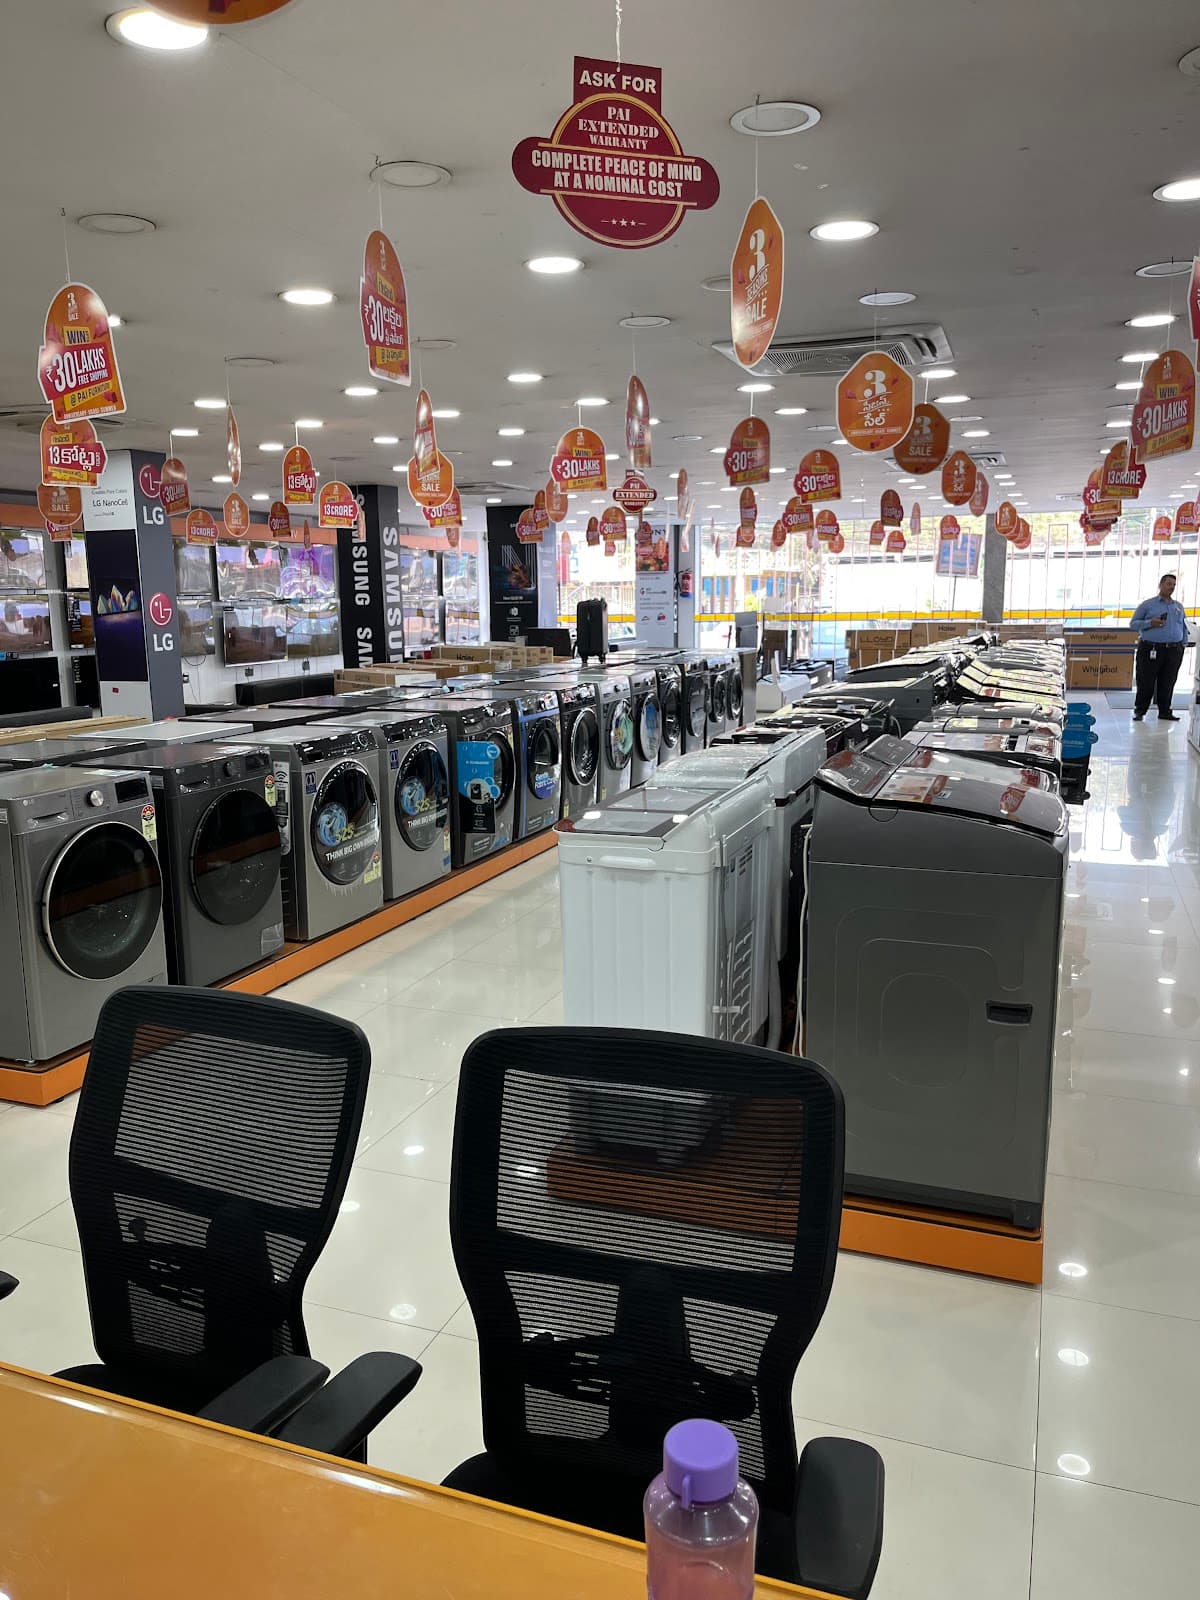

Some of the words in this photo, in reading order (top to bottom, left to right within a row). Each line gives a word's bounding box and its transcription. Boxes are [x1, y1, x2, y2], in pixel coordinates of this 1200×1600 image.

[579, 70, 616, 89] ASK
[621, 75, 657, 94] FOR
[607, 106, 630, 121] PAI
[577, 118, 659, 139] EXTENDED
[589, 134, 649, 151] WARRANTY
[531, 150, 602, 173] COMPLETE
[605, 159, 646, 177] PEACE
[649, 161, 665, 178] OF
[667, 163, 702, 182] MIND
[554, 171, 570, 188] AT
[573, 172, 583, 189] A
[585, 174, 646, 195] NOMINAL
[648, 179, 683, 198] COST
[749, 228, 766, 281] 3
[746, 298, 767, 322] SALE
[66, 330, 86, 345] WIN
[74, 347, 106, 373] LAKHS
[78, 373, 89, 386] FREE
[863, 369, 887, 399] 3
[77, 390, 88, 403] PAI
[1162, 399, 1188, 422] LAKHS
[913, 416, 931, 436] 3
[49, 446, 60, 465] 13
[908, 447, 933, 457] SALE
[1115, 470, 1141, 485] CRORE
[421, 483, 440, 492] SALE
[615, 491, 655, 500] EXTENDED
[52, 504, 71, 512] SALE
[92, 499, 102, 507] LG
[323, 504, 330, 516] 13
[331, 505, 353, 517] CRORE
[142, 505, 165, 525] LG
[153, 632, 174, 652] LG
[1081, 664, 1118, 674] Whirlpool
